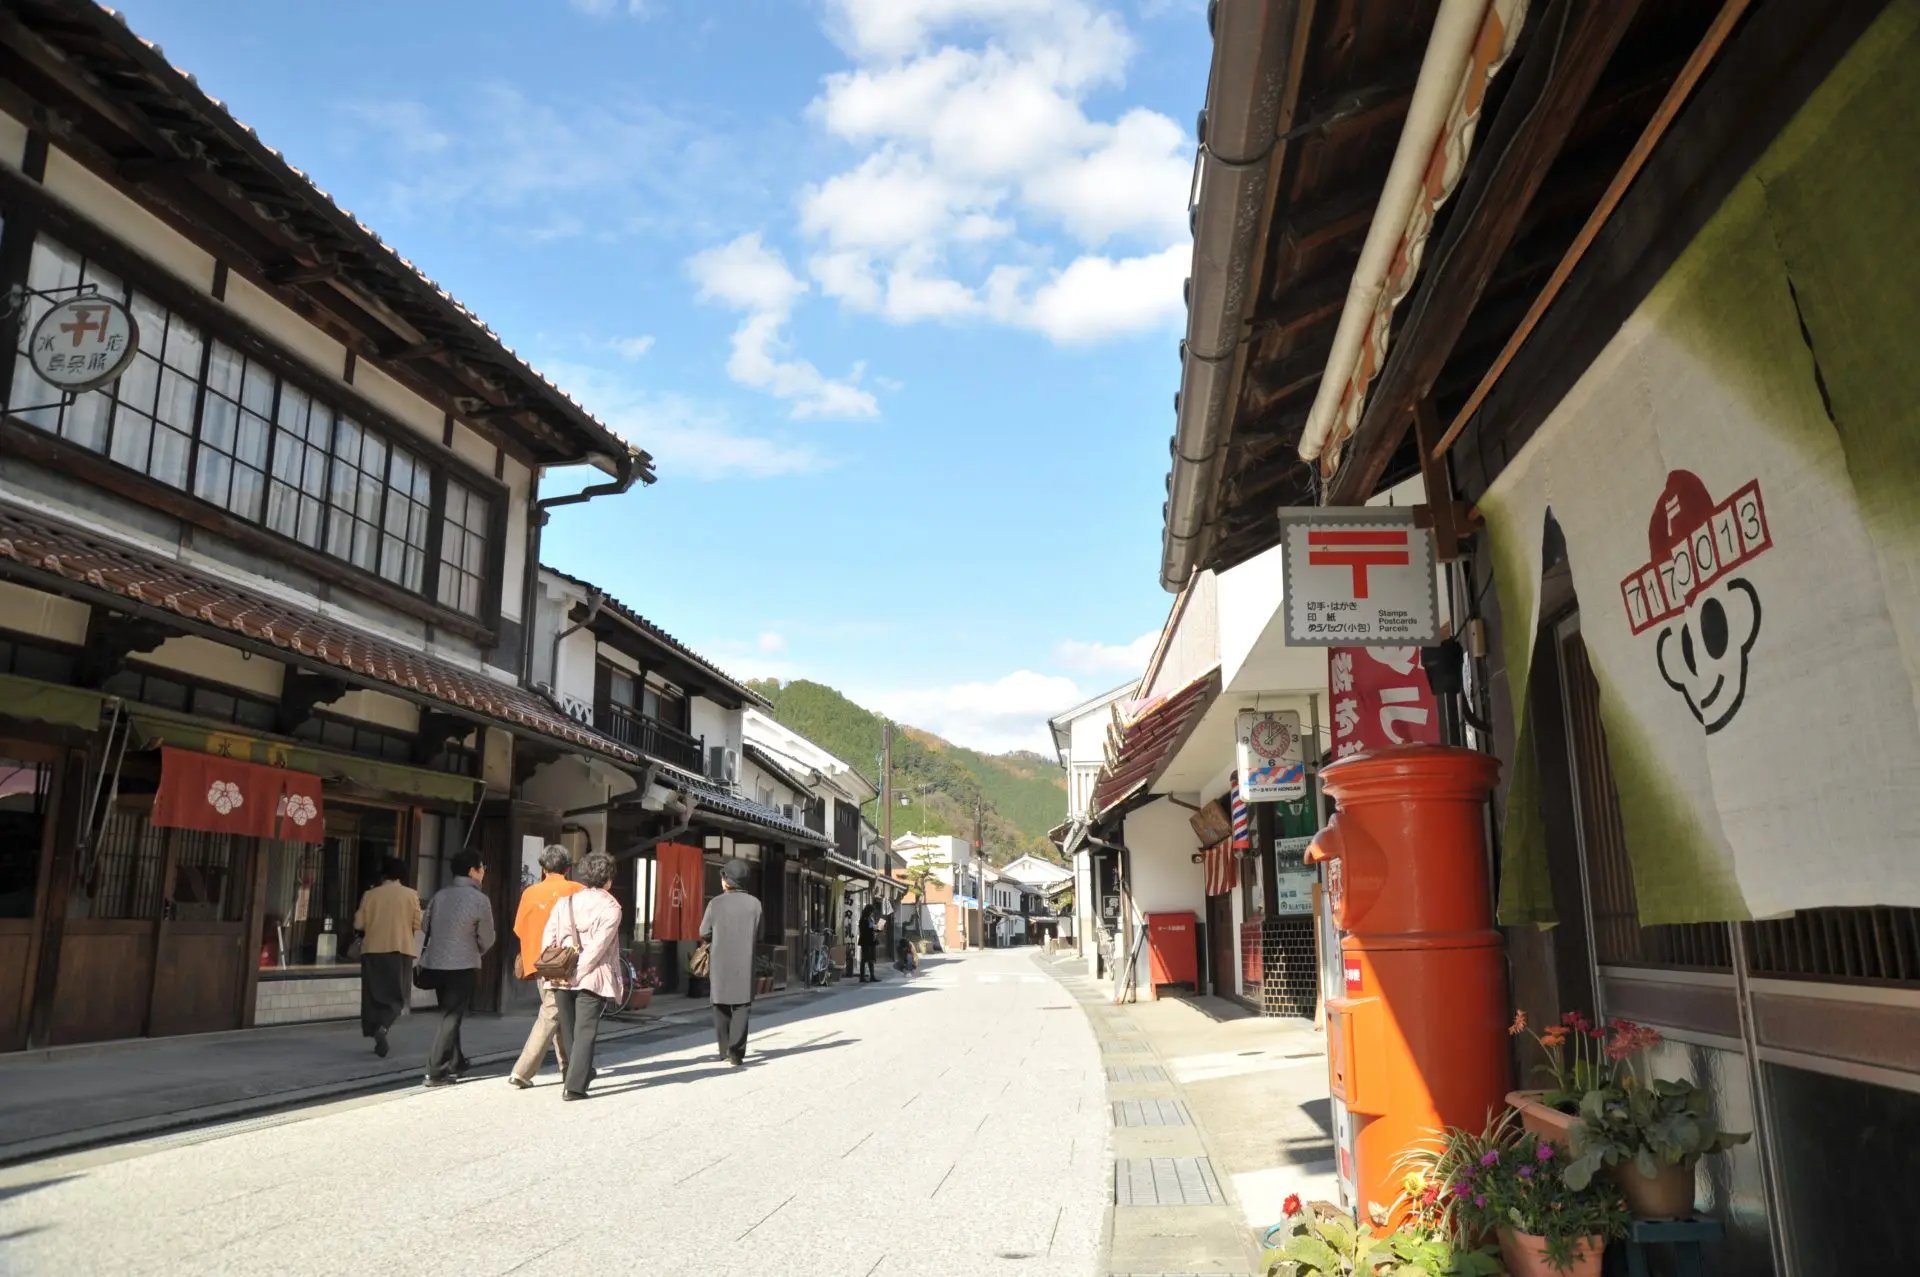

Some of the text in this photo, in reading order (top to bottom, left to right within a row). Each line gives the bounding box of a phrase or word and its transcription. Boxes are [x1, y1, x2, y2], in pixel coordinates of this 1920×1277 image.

[1627, 502, 1760, 618] 7170013
[1292, 734, 1299, 742] 3
[1268, 758, 1276, 767] 6
